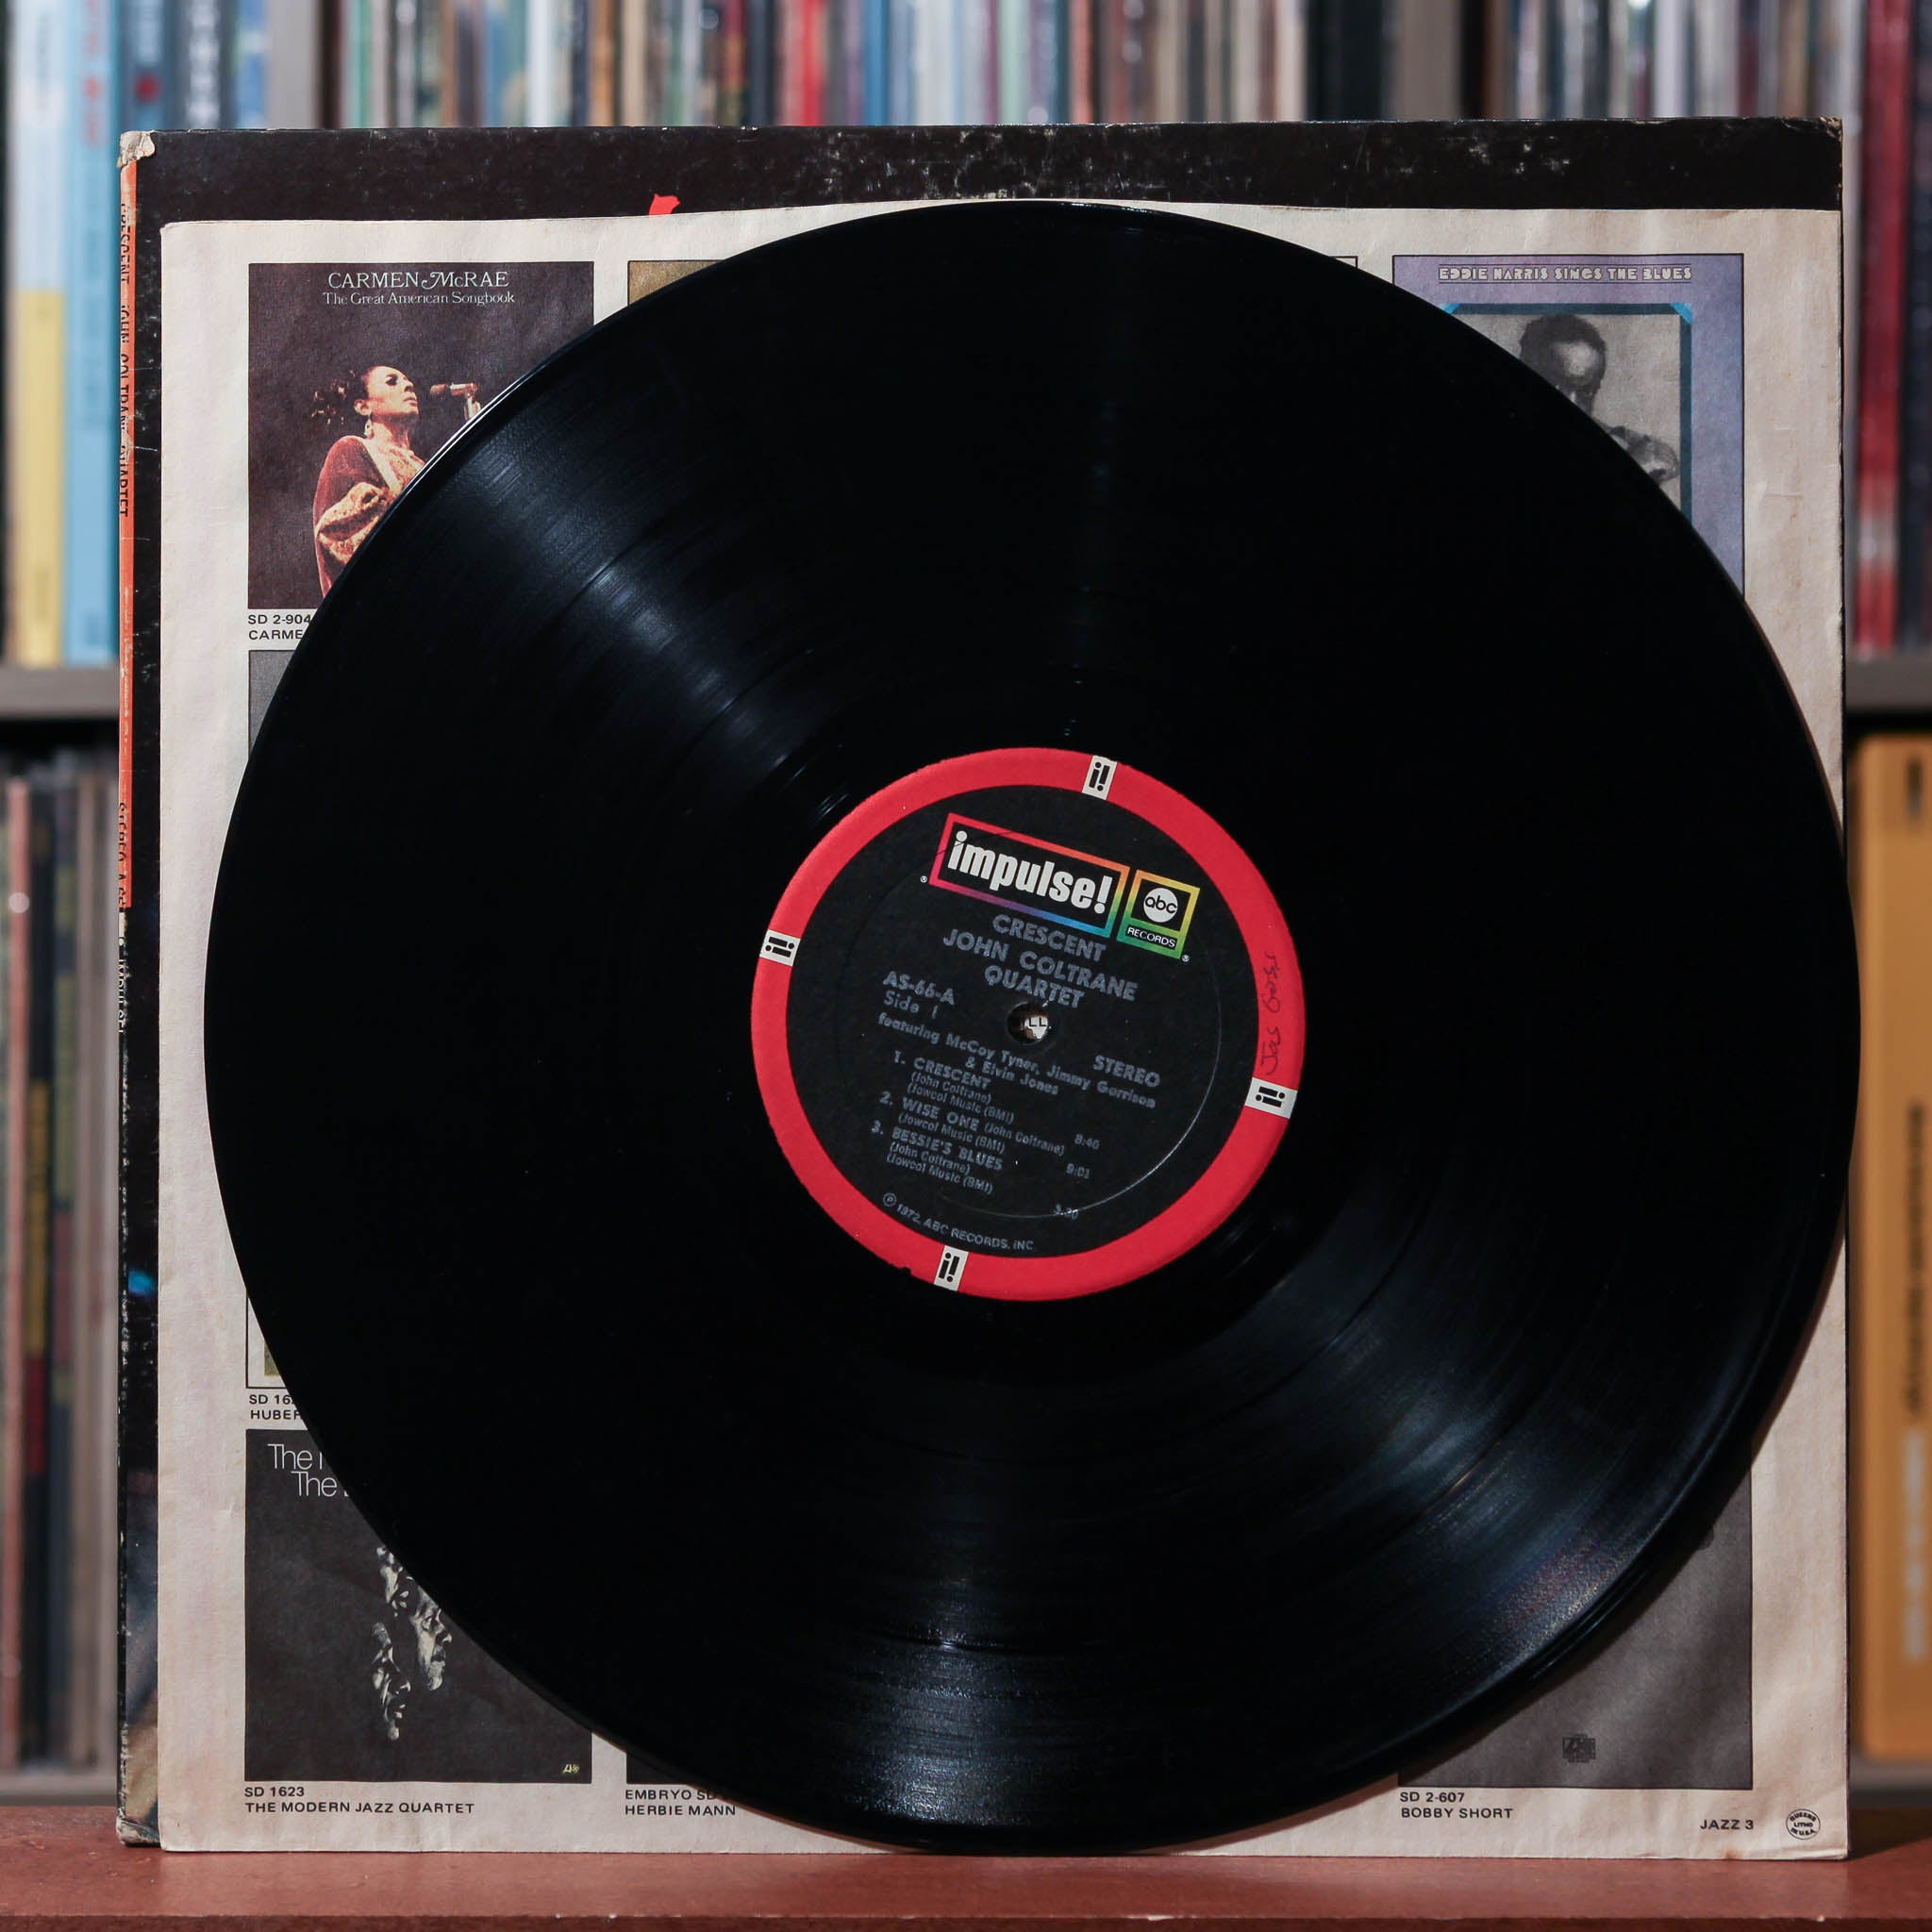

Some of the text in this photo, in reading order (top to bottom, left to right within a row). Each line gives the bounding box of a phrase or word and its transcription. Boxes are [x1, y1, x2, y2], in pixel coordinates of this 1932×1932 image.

[328, 272, 509, 290] CARMEN McRAE
[1438, 266, 1691, 280] EDDIE HARRIS SINGS THE BLUES
[323, 291, 514, 306] The Great American Songbook
[248, 614, 268, 625] SD
[248, 629, 304, 641] CARME
[948, 831, 1112, 913] impulse!
[1144, 893, 1177, 914] abc
[992, 914, 1106, 961] CRESCENT
[1127, 927, 1174, 947] RECORDS
[943, 929, 1137, 1001] JOHN COLTRANE
[883, 971, 954, 1005] AS-66-A
[985, 965, 1084, 1008] QUARTET
[884, 991, 919, 1012] Side
[878, 1012, 940, 1044] featuring
[946, 1034, 995, 1060] McCoy
[1047, 1065, 1091, 1091] Jimmy
[914, 1058, 991, 1089] CRESCENT
[1093, 1056, 1159, 1087] STEREO
[903, 1097, 940, 1119] WISE
[947, 1112, 979, 1131] ONE
[892, 1127, 952, 1155] BESSIE'S
[958, 1147, 1002, 1170] BLUES
[923, 1219, 949, 1234] ABC
[249, 1394, 295, 1405] SD 16
[267, 1443, 313, 1470] The
[291, 1471, 338, 1497] The
[244, 1787, 305, 1797] SD 1623
[625, 1790, 691, 1800] EMBRYO
[1400, 1791, 1465, 1803] SD 2-607
[245, 1802, 475, 1813] THE MODERN JAZZ QUARTET
[625, 1805, 736, 1816] HERBIE MANN
[1401, 1807, 1514, 1819] BOBBY SHORT
[1700, 1820, 1754, 1830] JAZZ 3
